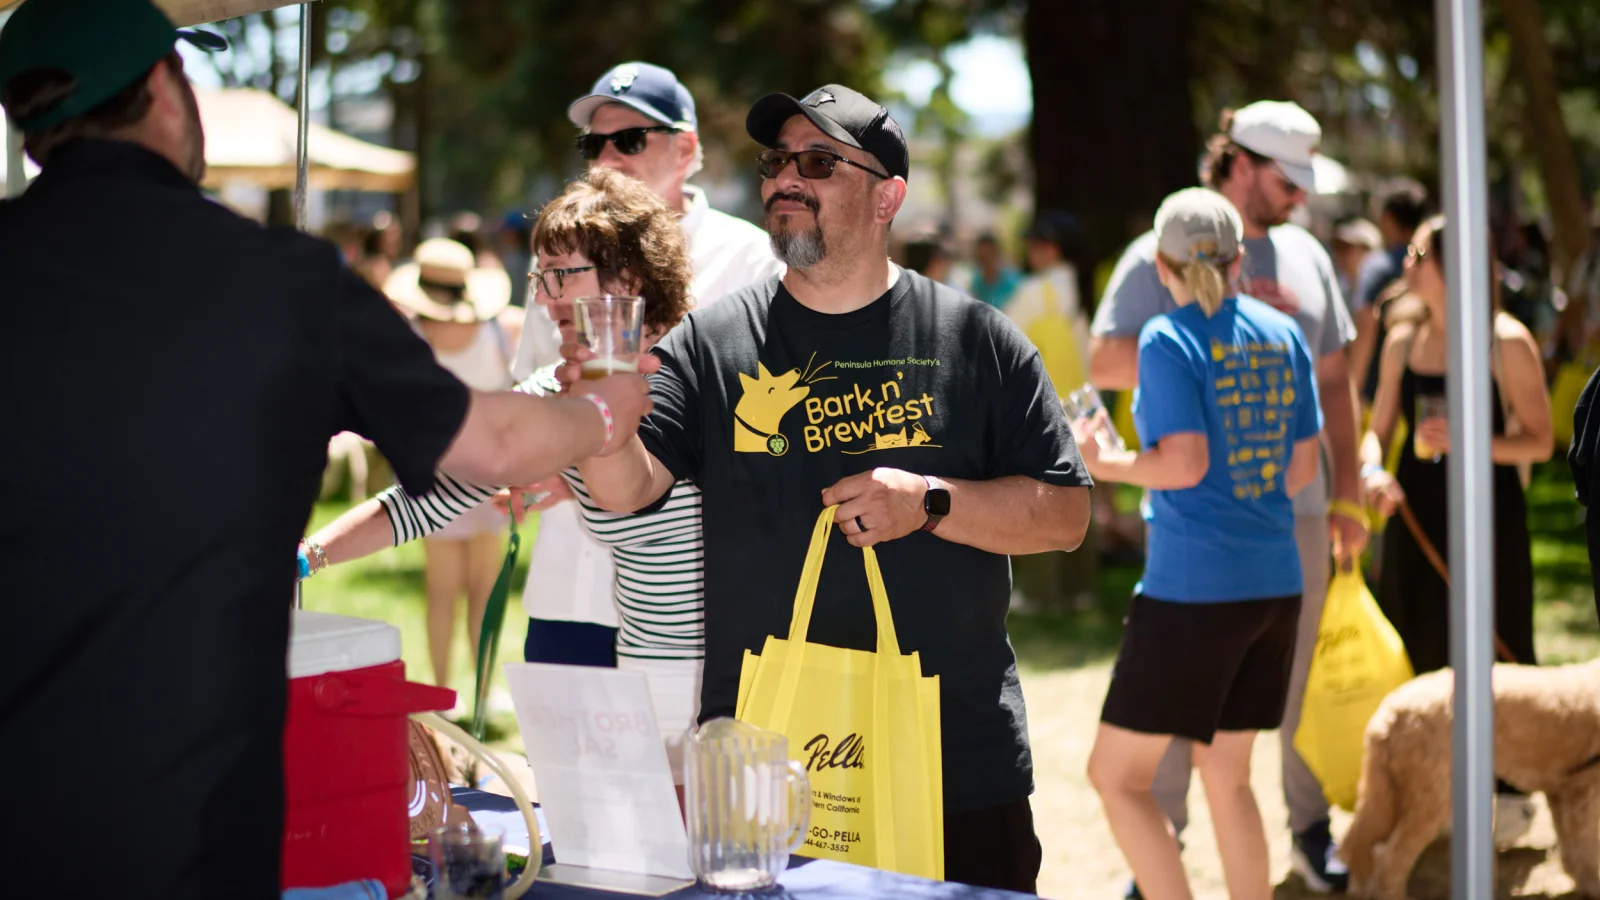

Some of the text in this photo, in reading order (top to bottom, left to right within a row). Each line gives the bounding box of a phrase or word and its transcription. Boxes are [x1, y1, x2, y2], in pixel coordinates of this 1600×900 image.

[834, 356, 941, 369] Peninsula Humane Society's
[805, 371, 904, 424] Bark n'
[803, 393, 934, 453] Brewfest
[823, 791, 856, 803] Windows
[809, 826, 861, 842] -GO-PELLA
[803, 838, 850, 852] 44-467-3552
